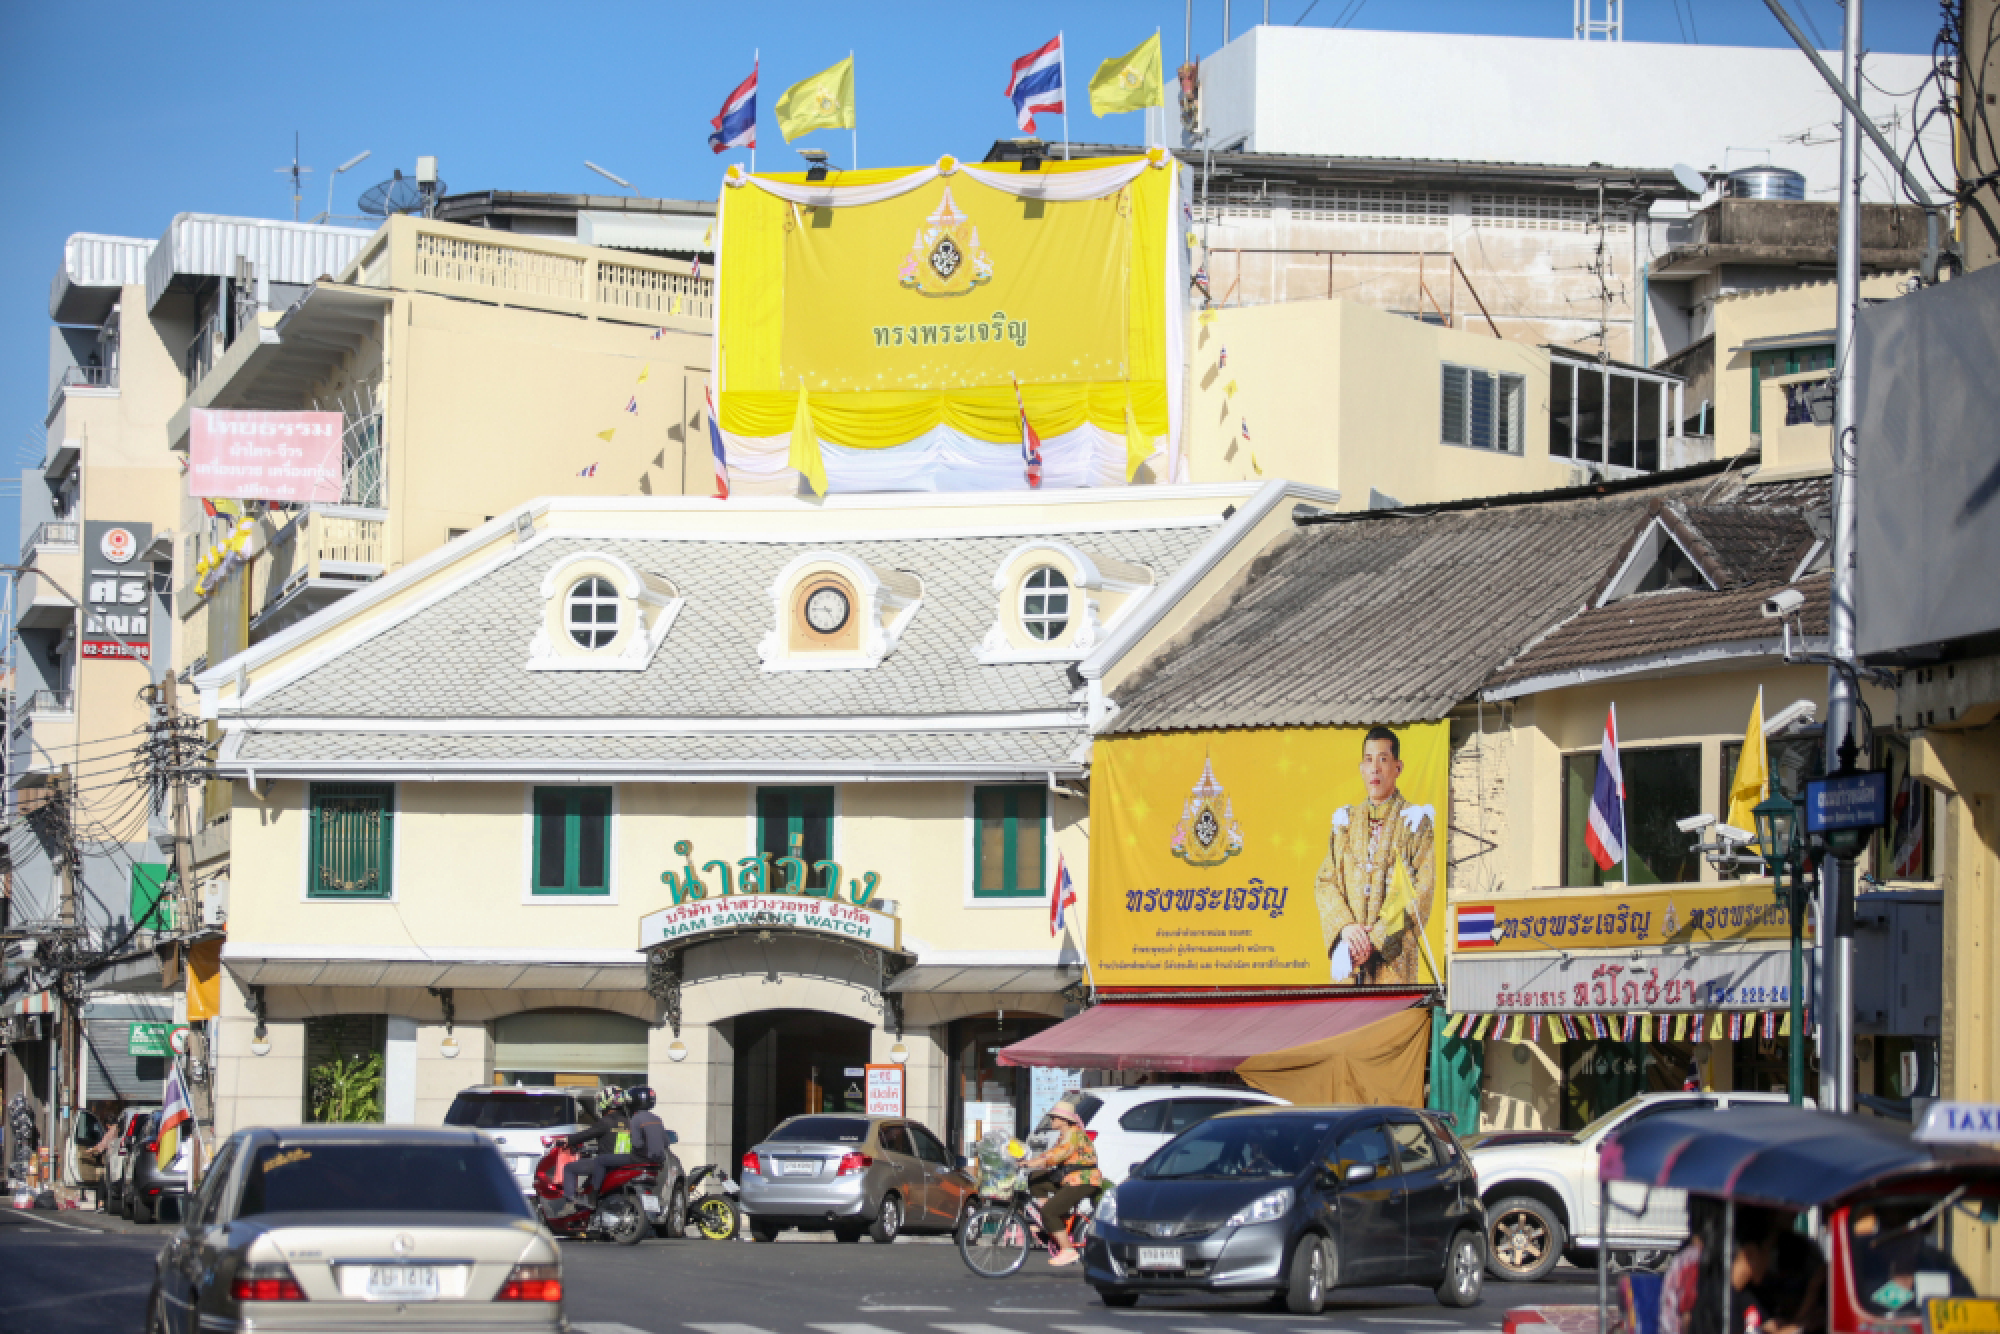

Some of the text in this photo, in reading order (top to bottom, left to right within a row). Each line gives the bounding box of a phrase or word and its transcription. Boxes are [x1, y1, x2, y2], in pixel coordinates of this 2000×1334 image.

[873, 310, 1028, 348] ทรงพระเจริญ
[666, 903, 712, 924] บริษัท
[828, 903, 871, 924] จำกัด
[1125, 877, 1289, 918] ทรงพระเจริญ
[663, 916, 707, 938] NAM
[804, 913, 872, 938] WATCH
[1503, 903, 1652, 941] ทรงพระเจริญ
